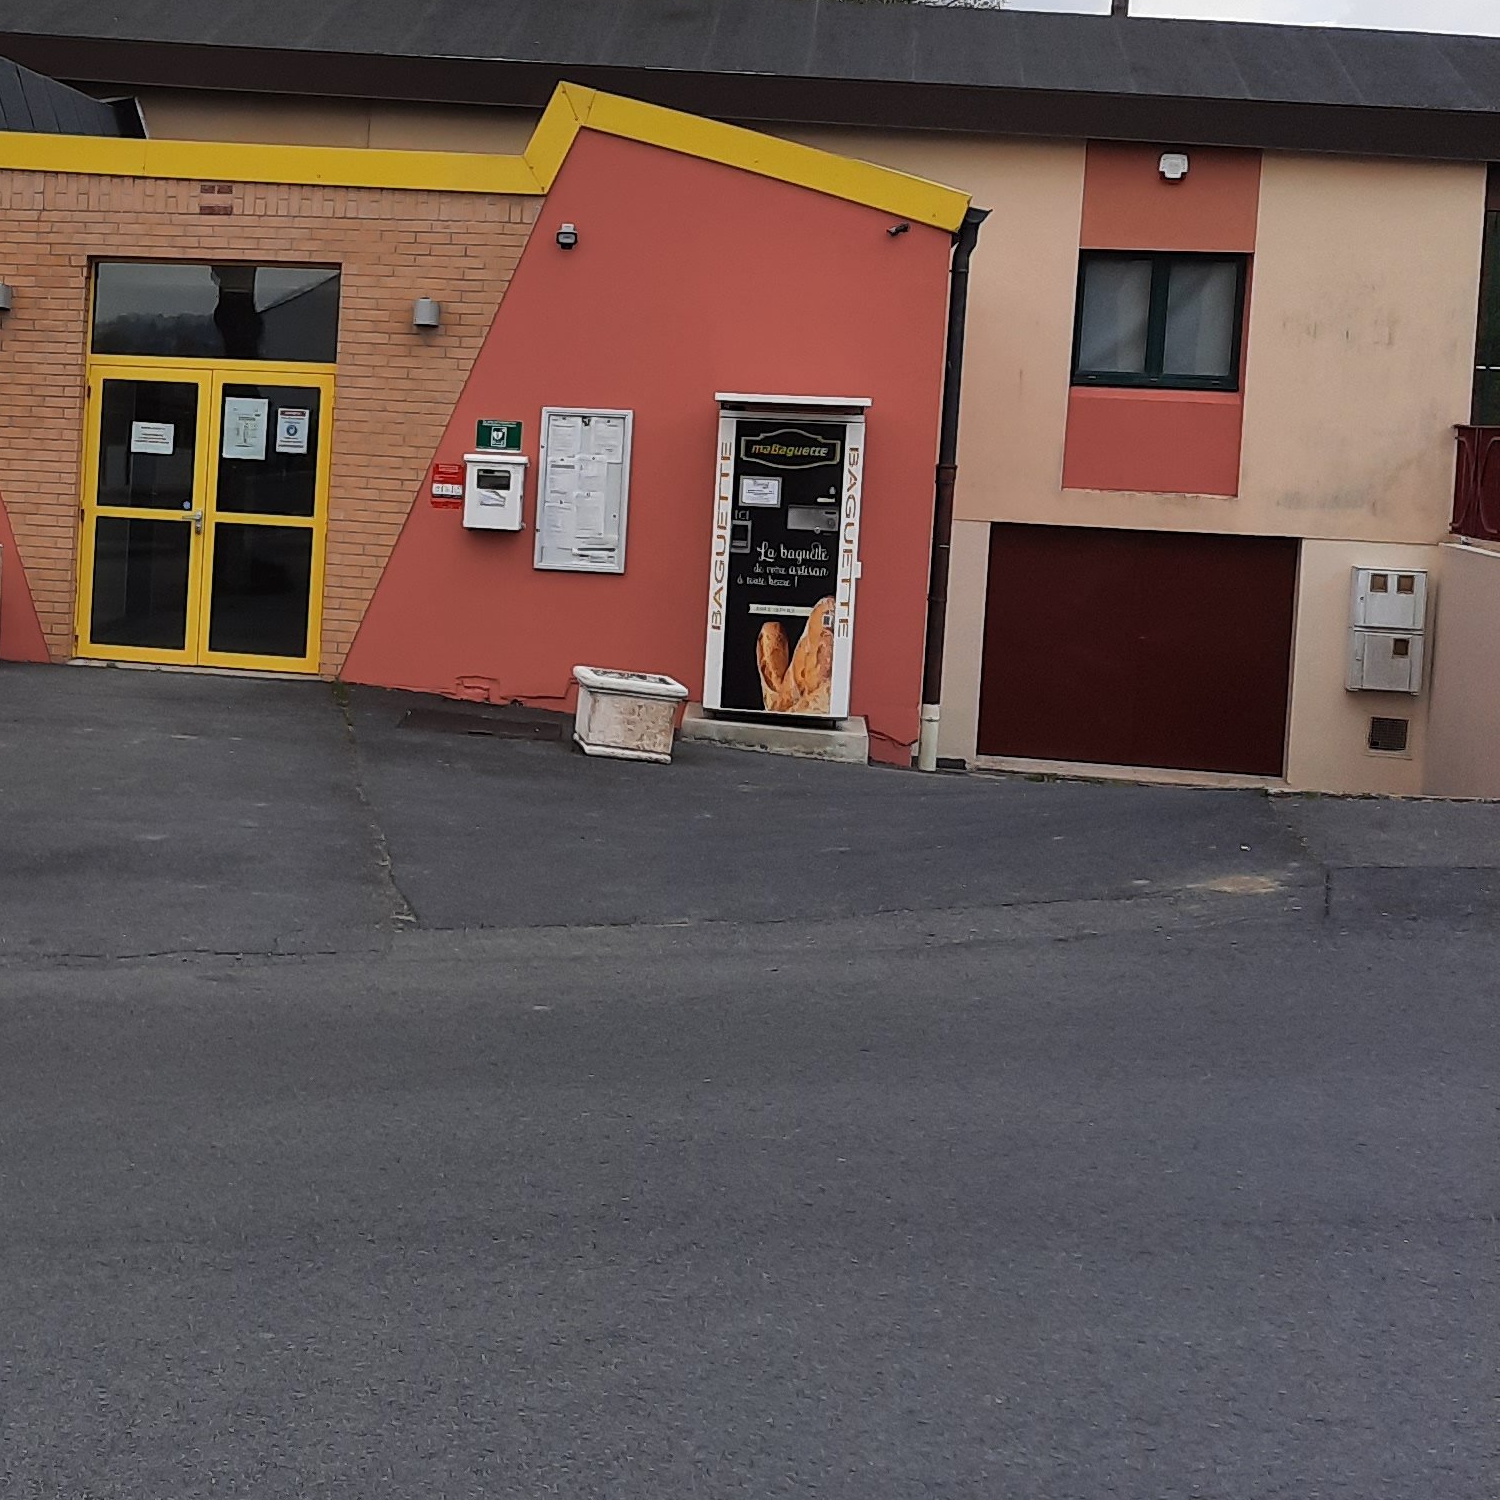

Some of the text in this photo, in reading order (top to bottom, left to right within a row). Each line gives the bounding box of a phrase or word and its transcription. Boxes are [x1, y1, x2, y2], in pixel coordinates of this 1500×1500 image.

[751, 443, 829, 457] maBaguette
[735, 509, 750, 520] ICI
[711, 441, 733, 631] BAGUETTE
[838, 447, 860, 638] BAGUETTE
[756, 541, 829, 564] La baguette
[788, 565, 829, 577] artisan
